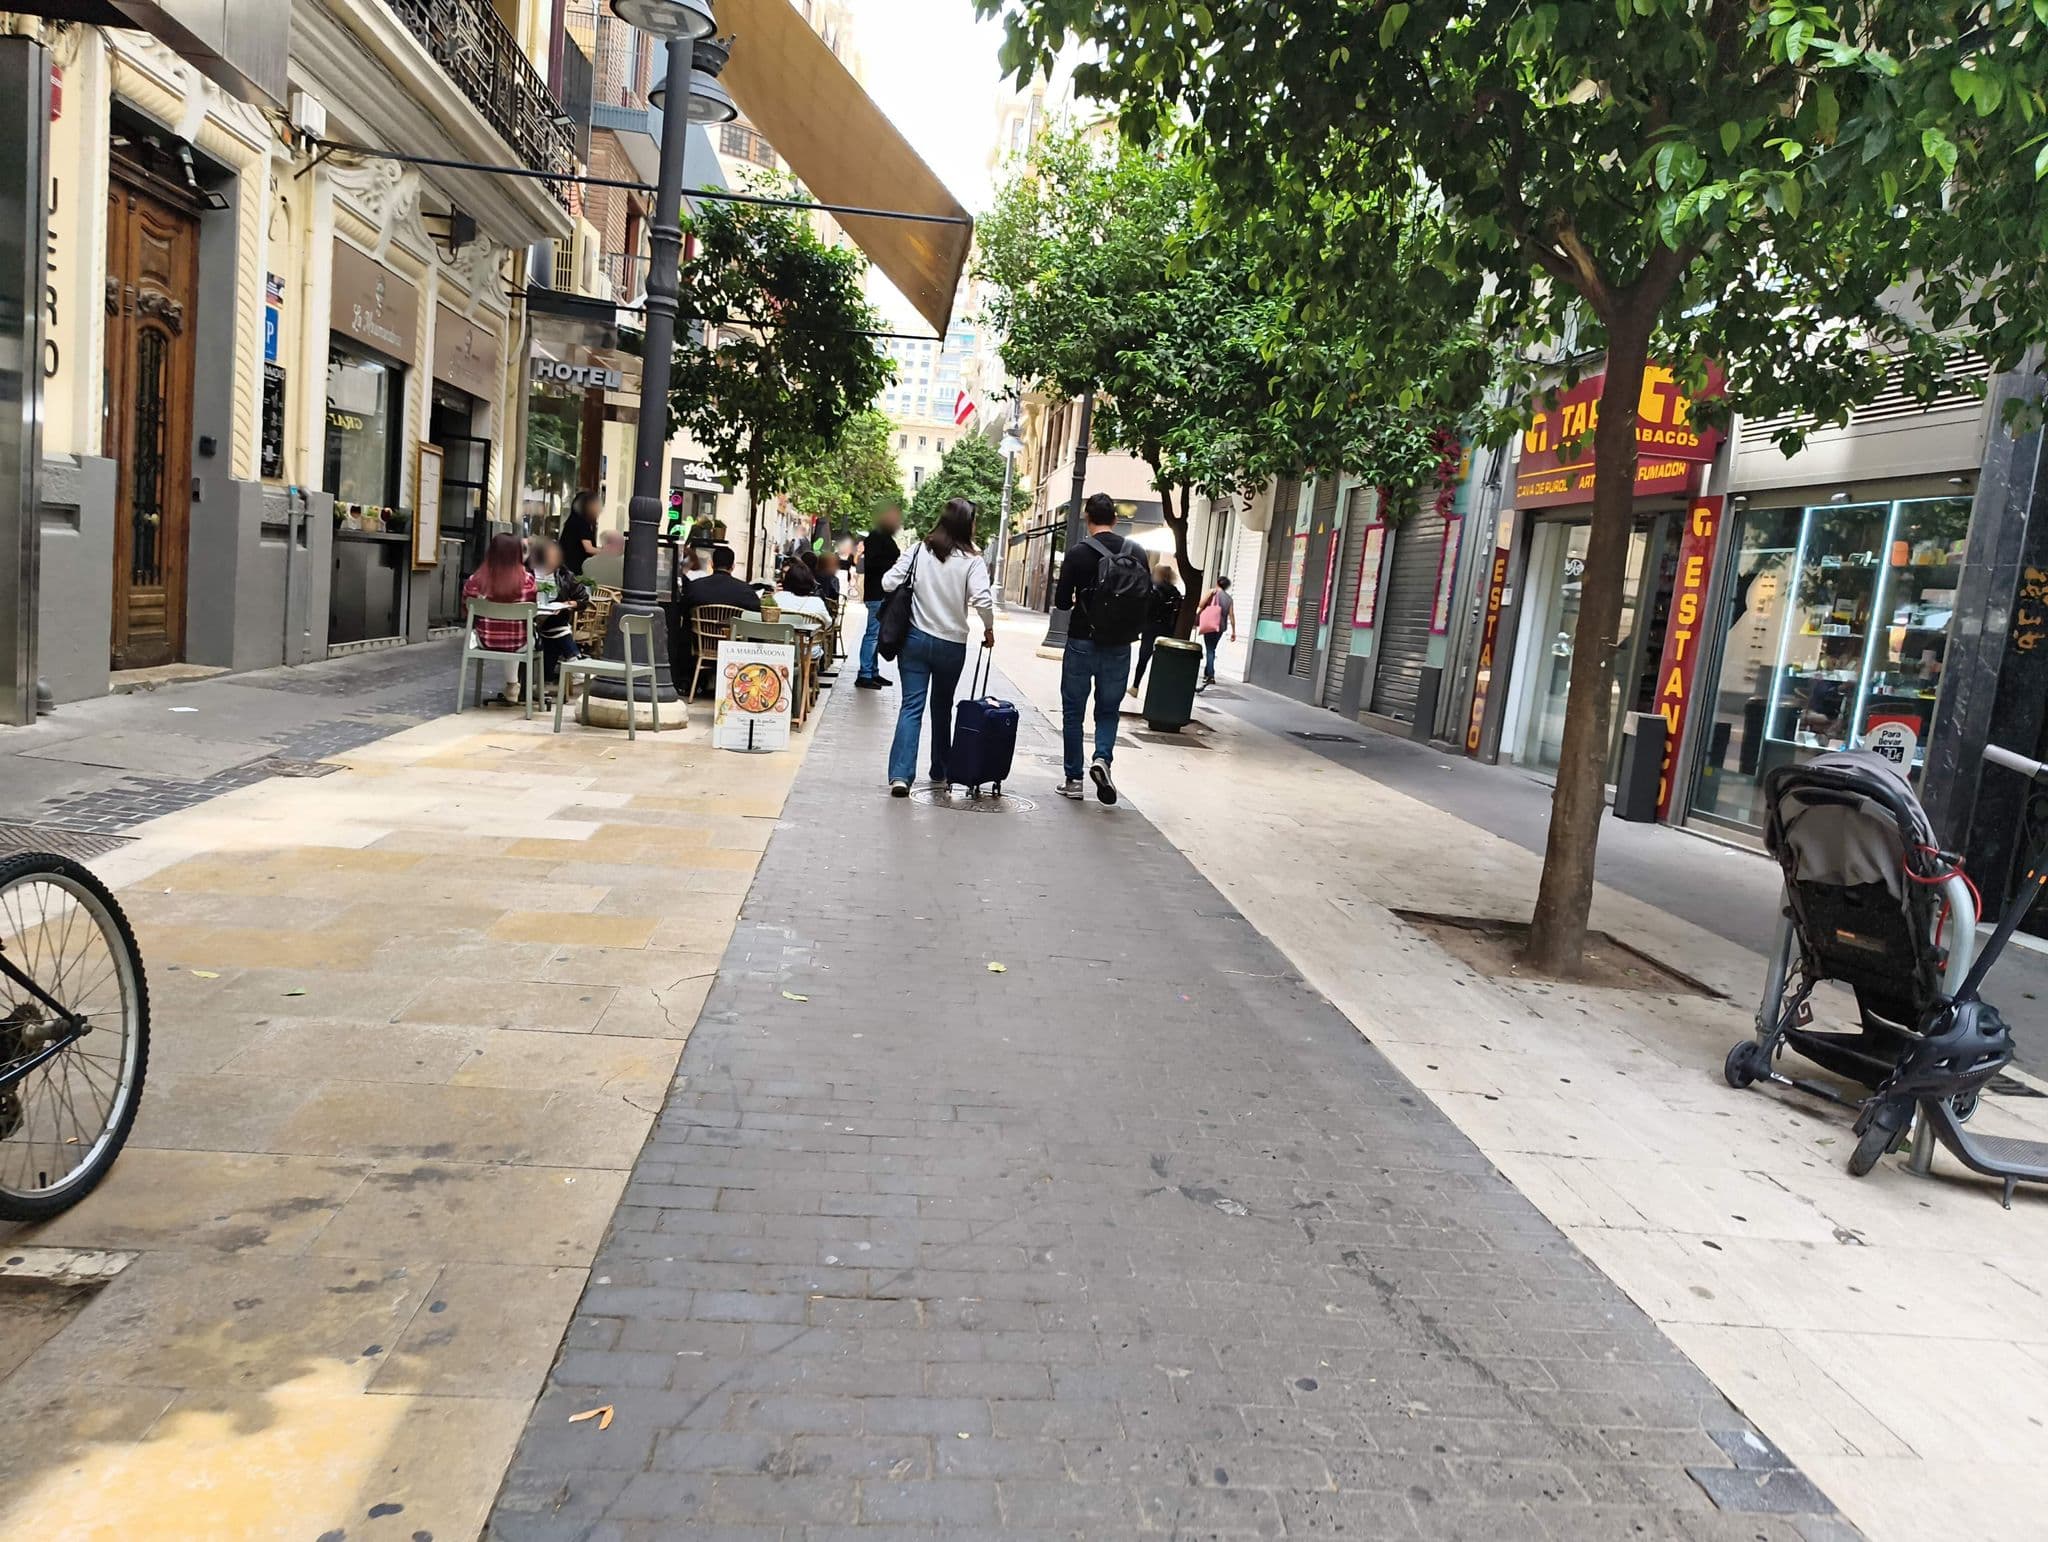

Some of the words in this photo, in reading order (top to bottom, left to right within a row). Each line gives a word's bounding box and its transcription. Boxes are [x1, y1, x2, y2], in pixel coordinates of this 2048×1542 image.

[537, 360, 621, 388] HOTEL
[1635, 428, 1699, 447] BACOS
[1468, 558, 1506, 750] ESTANCO
